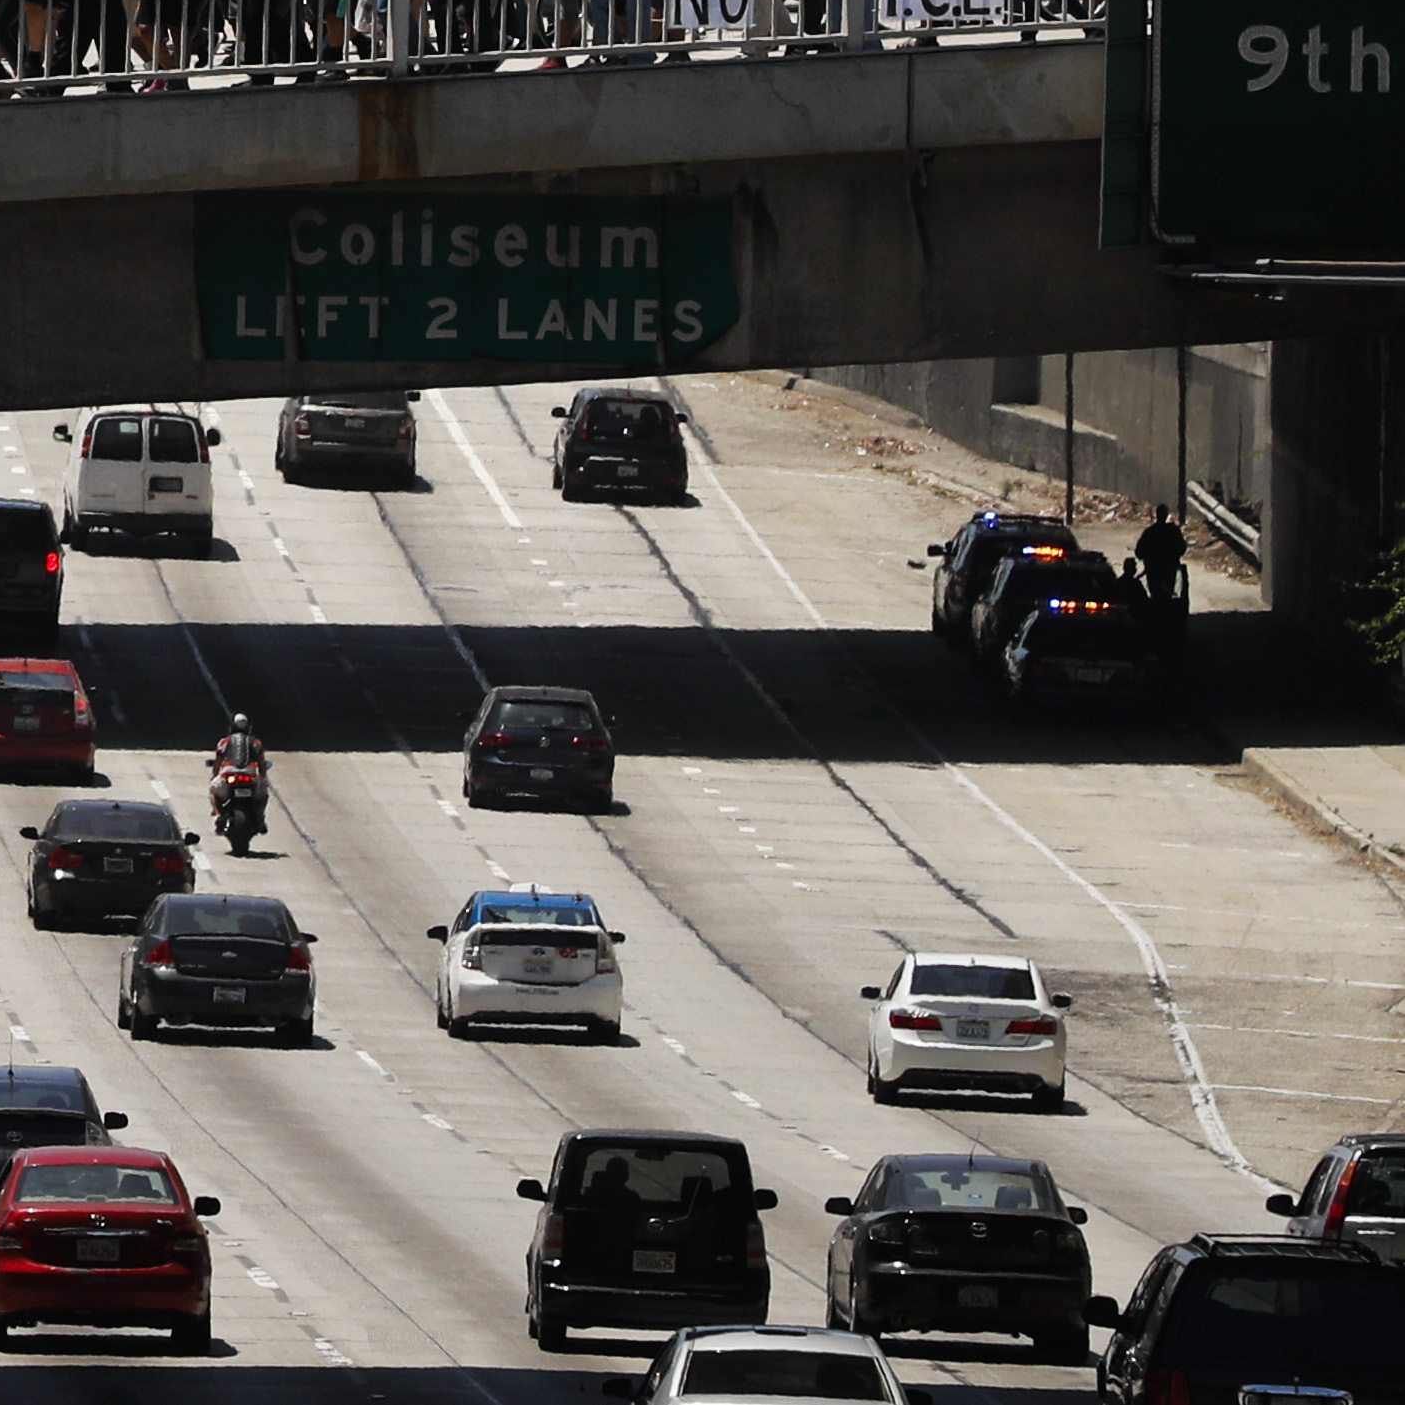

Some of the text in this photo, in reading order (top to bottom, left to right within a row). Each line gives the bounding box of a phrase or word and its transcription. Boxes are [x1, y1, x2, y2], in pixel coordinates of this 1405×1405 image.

[1238, 25, 1391, 93] 9th
[291, 208, 658, 269] Coliseum
[425, 297, 458, 340] 2
[497, 299, 705, 342] LANES
